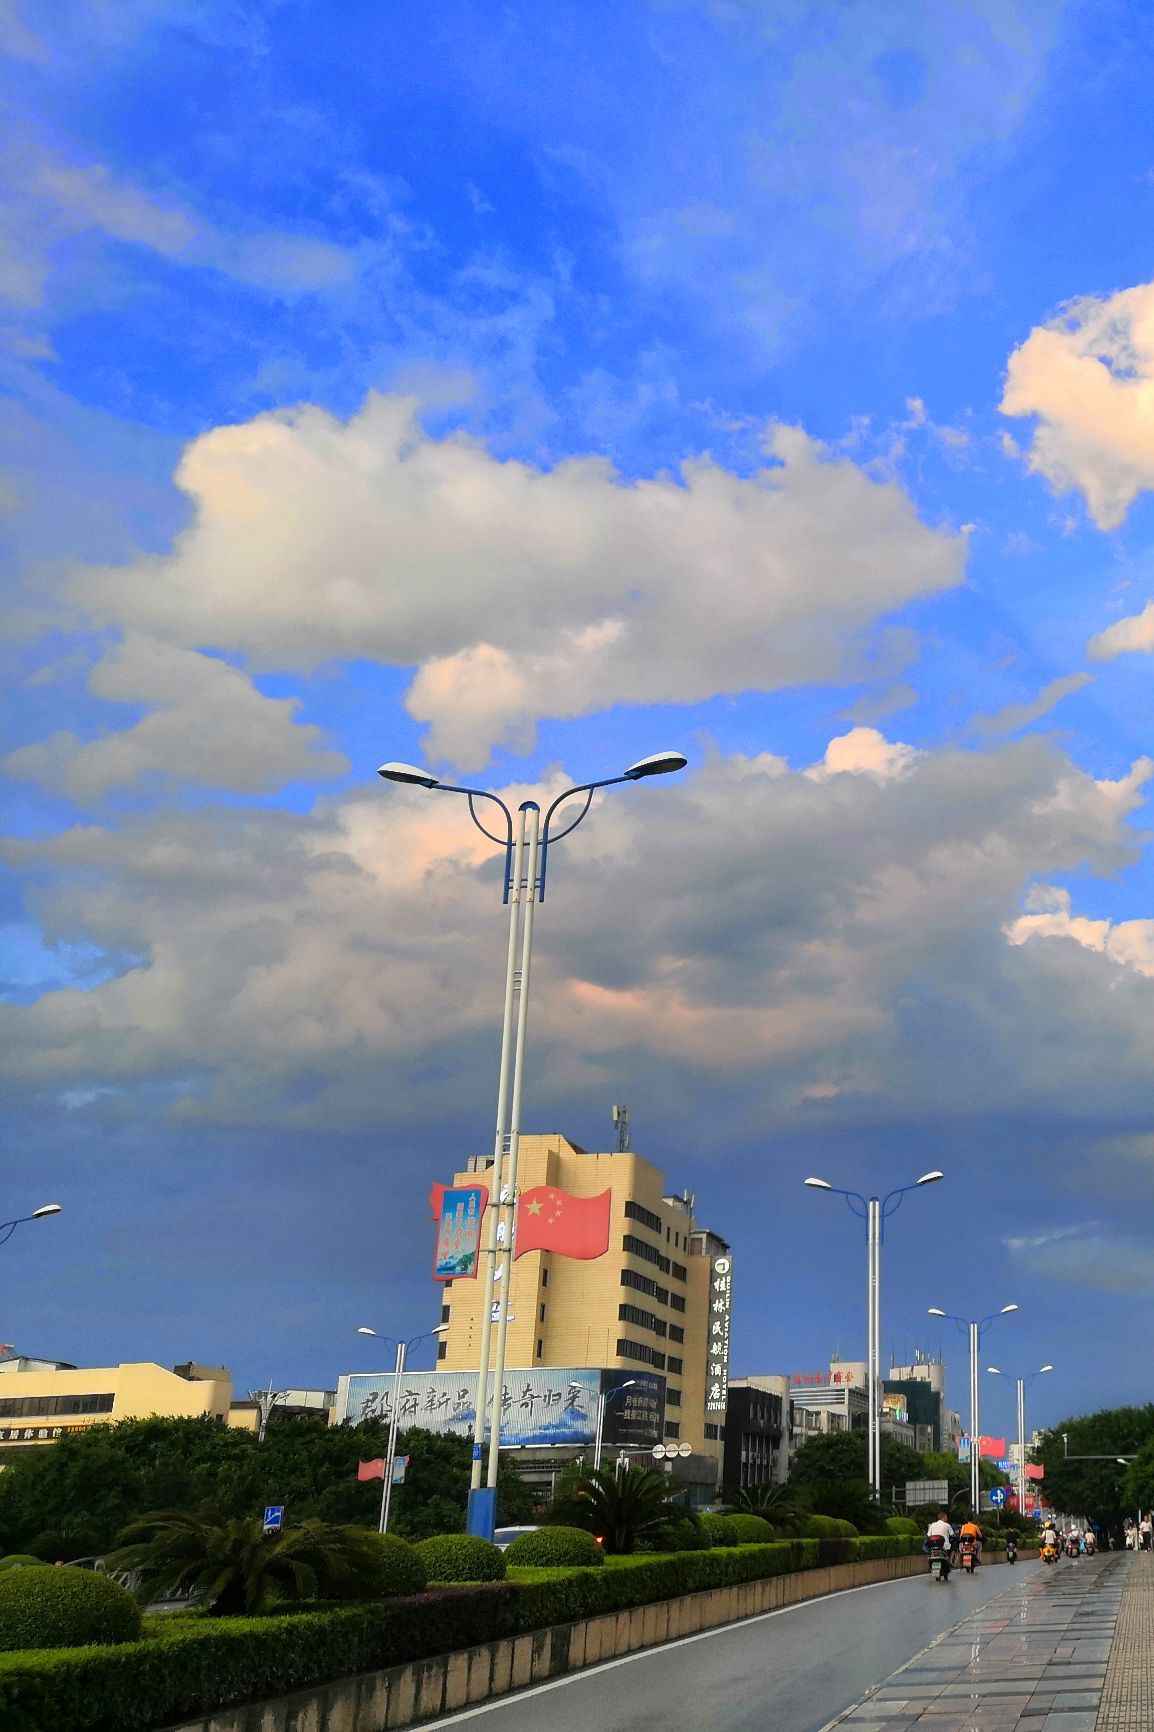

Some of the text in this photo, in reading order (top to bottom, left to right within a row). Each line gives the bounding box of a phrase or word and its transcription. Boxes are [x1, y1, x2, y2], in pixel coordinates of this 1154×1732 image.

[709, 1277, 727, 1400] 桂林民航酒店
